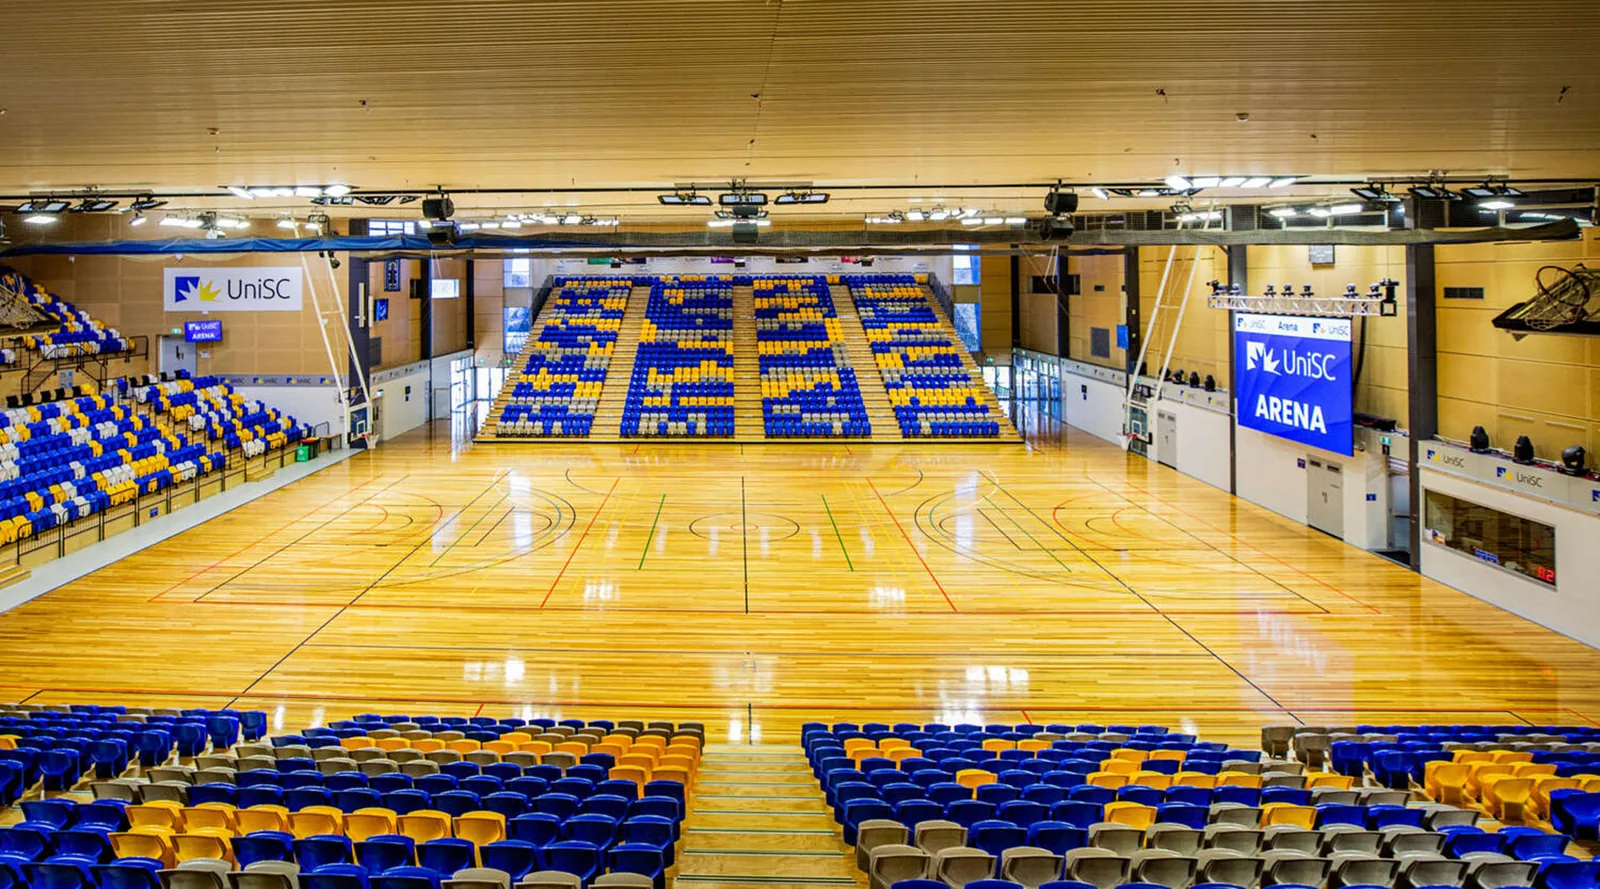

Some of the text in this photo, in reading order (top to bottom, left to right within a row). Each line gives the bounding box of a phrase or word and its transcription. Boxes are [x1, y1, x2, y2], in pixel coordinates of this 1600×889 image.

[227, 278, 291, 300] UniSC
[1278, 320, 1299, 332] Arena
[1328, 325, 1349, 336] UniSC
[1283, 349, 1336, 381] UniSC
[1255, 394, 1327, 434] ARENA
[1443, 455, 1465, 468] UniSC
[1516, 472, 1543, 488] UniSC
